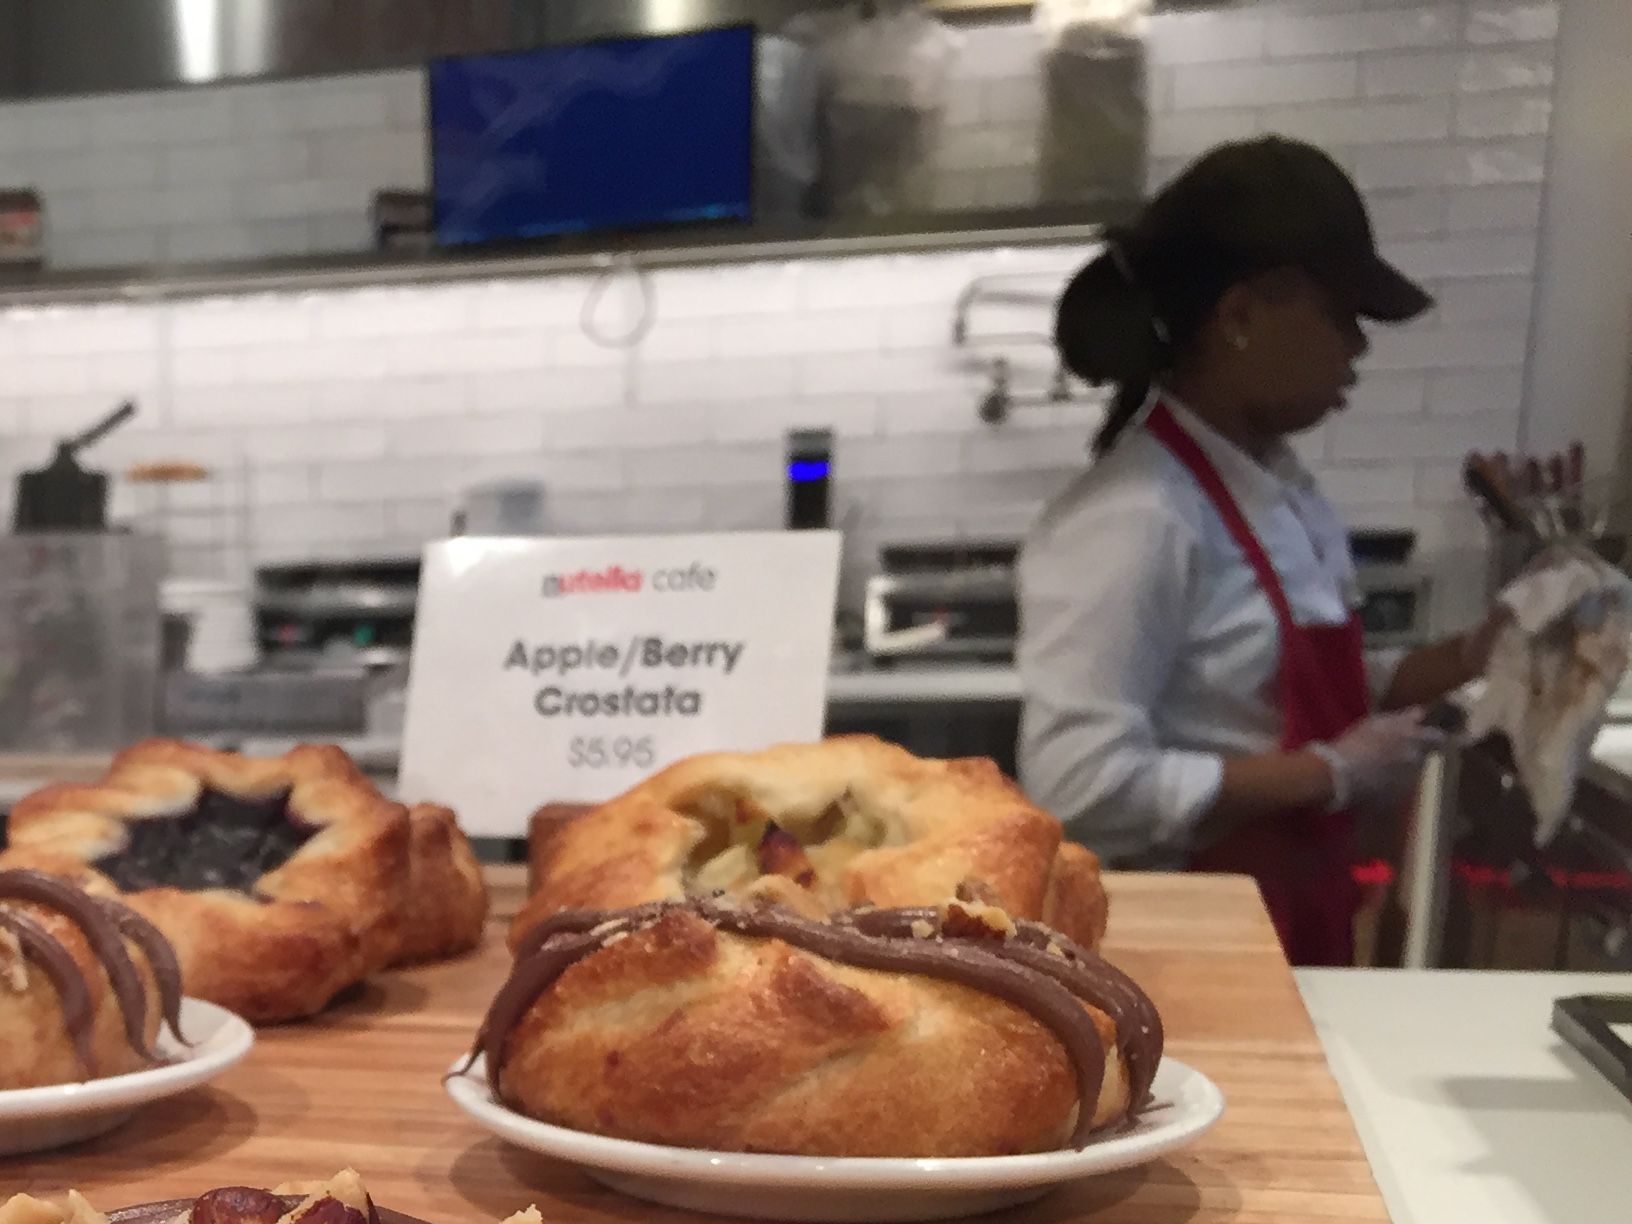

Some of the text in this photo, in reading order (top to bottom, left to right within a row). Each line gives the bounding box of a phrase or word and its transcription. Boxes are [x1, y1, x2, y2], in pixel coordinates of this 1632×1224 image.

[542, 561, 717, 597] nutella cafe
[504, 637, 744, 675] Apple/Berry
[534, 686, 701, 716] Crostata
